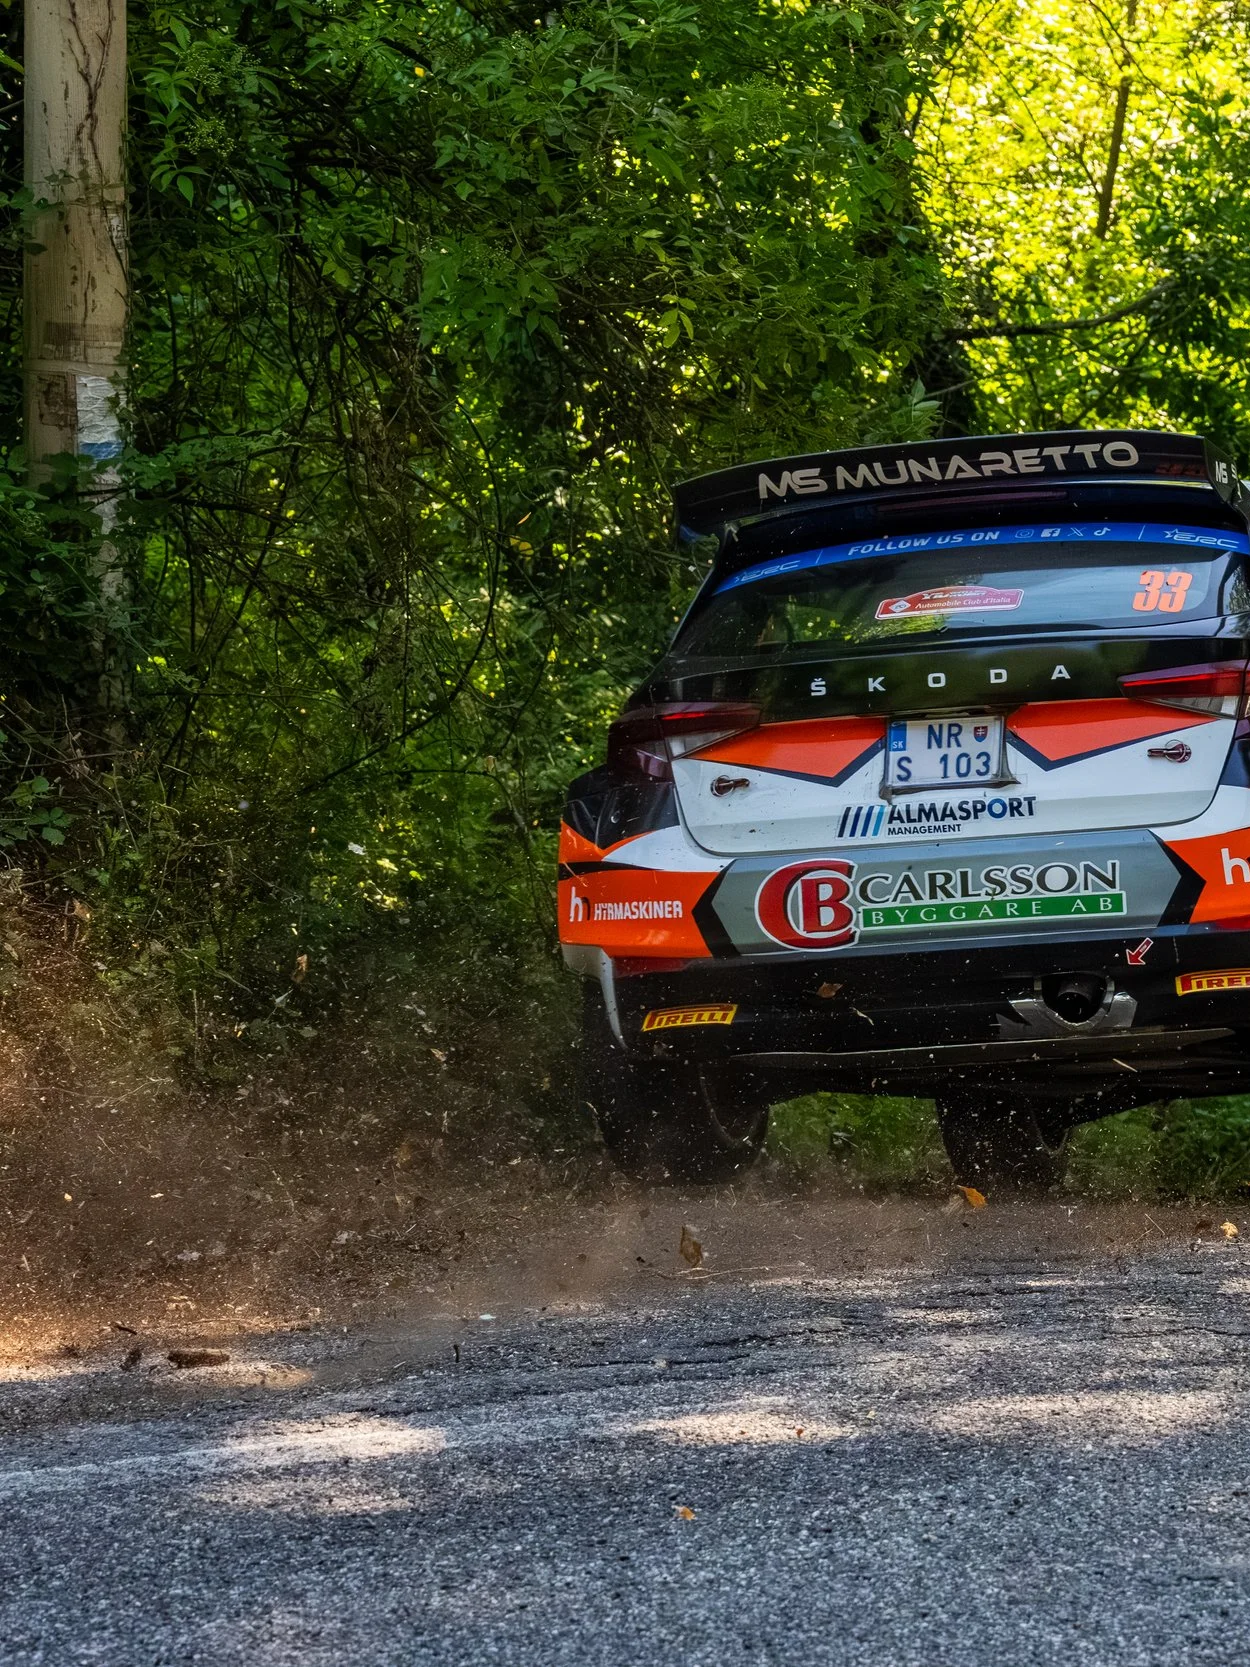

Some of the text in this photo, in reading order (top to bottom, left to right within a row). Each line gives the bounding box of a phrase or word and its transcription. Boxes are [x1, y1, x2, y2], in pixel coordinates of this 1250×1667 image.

[758, 441, 1139, 500] MS MUNARETTO
[848, 531, 1000, 556] FOLLOW US ON
[914, 600, 962, 609] Automobile
[963, 598, 981, 606] Club
[1132, 570, 1193, 613] 33
[810, 664, 1071, 697] ŠKODA
[892, 741, 904, 750] SK
[927, 722, 963, 750] NR
[896, 751, 991, 782] S 103
[887, 796, 1037, 825] ALMASPORT
[887, 824, 962, 836] MANAGEMENT
[858, 861, 1119, 905] CARLSSON
[594, 900, 684, 921] HYRMASKINER
[872, 898, 1113, 925] BYGGARE AB
[644, 1003, 734, 1029] PIRELLI
